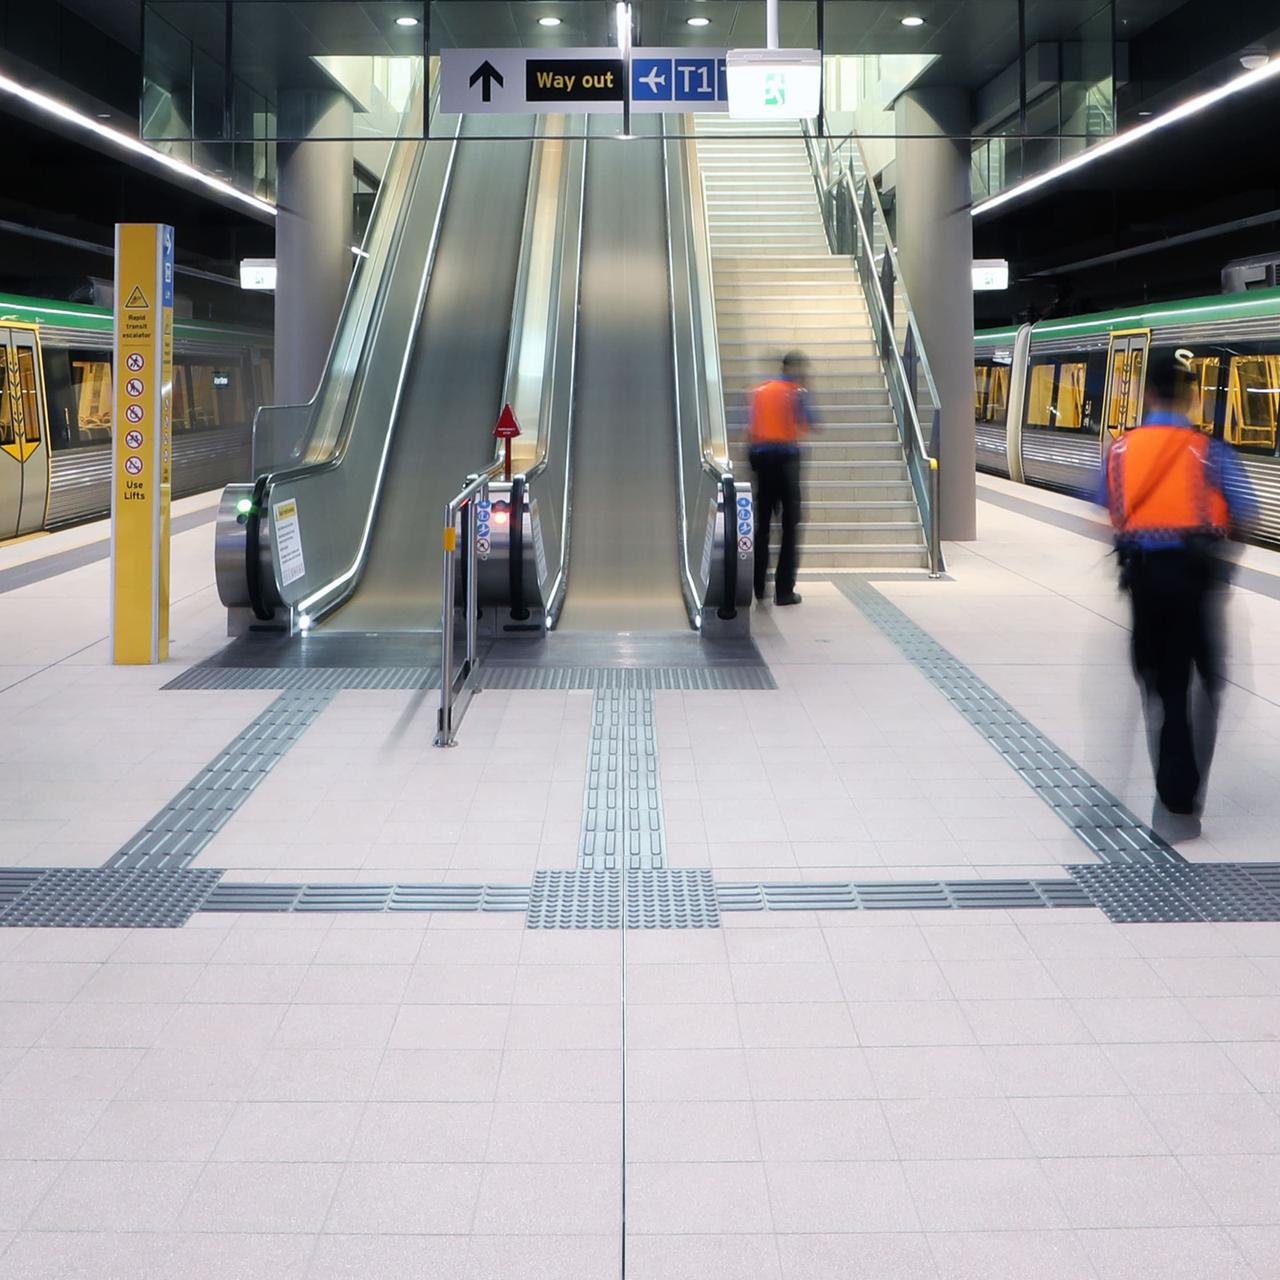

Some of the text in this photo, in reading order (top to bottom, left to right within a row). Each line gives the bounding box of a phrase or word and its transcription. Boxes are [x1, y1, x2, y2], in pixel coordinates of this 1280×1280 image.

[536, 71, 614, 92] Way out
[677, 66, 713, 93] T1
[128, 314, 146, 322] Rapid
[126, 480, 144, 489] Use
[124, 491, 146, 500] Lifts
